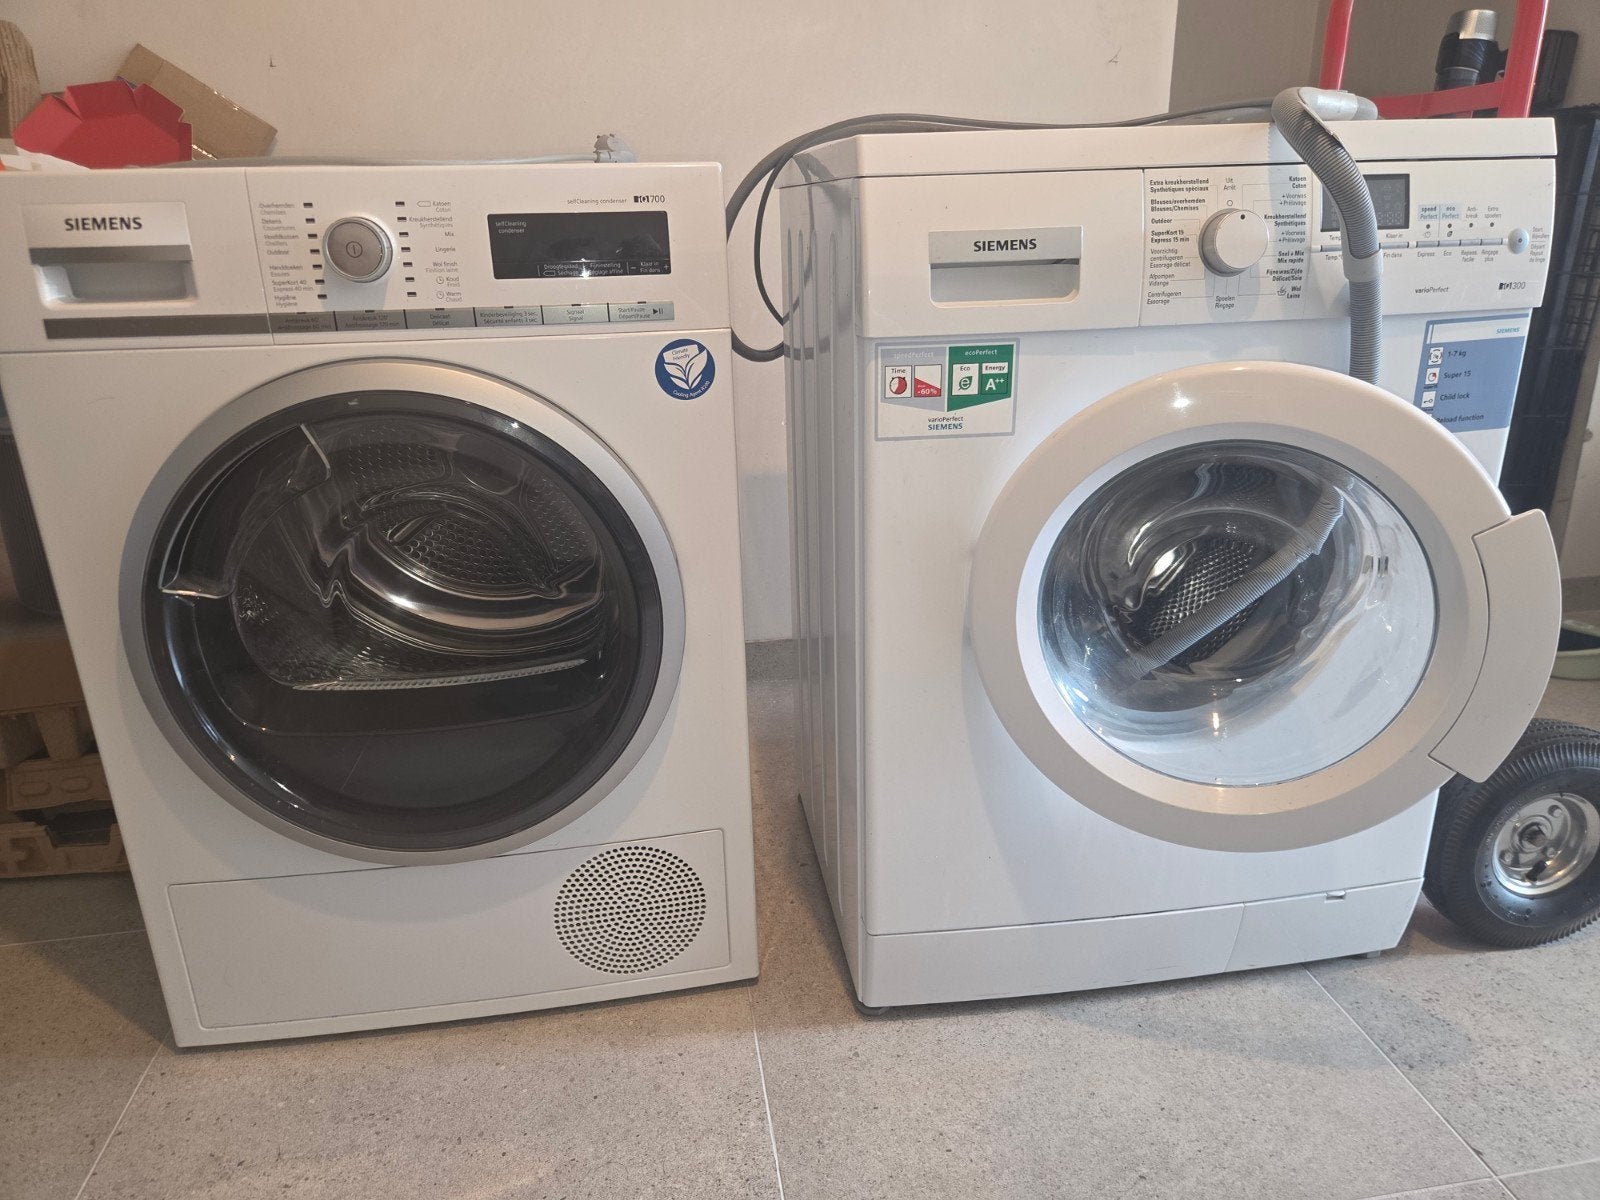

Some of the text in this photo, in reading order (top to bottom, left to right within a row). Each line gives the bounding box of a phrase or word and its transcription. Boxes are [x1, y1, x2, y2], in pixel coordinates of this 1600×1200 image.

[64, 217, 143, 232] SIEMENS
[495, 220, 527, 228] selfCleaning
[973, 238, 1038, 252] SIEMENS
[1415, 286, 1449, 294] varioPerfect
[1215, 295, 1236, 303] Spoelen
[1496, 327, 1520, 335] SIEMENS
[893, 351, 934, 361] speedPerfect
[1458, 350, 1467, 358] kg
[1443, 371, 1461, 379] Super
[985, 378, 1005, 391] A++
[1440, 393, 1456, 401] Child
[1458, 414, 1485, 423] function
[928, 423, 963, 431] SIEMENS
